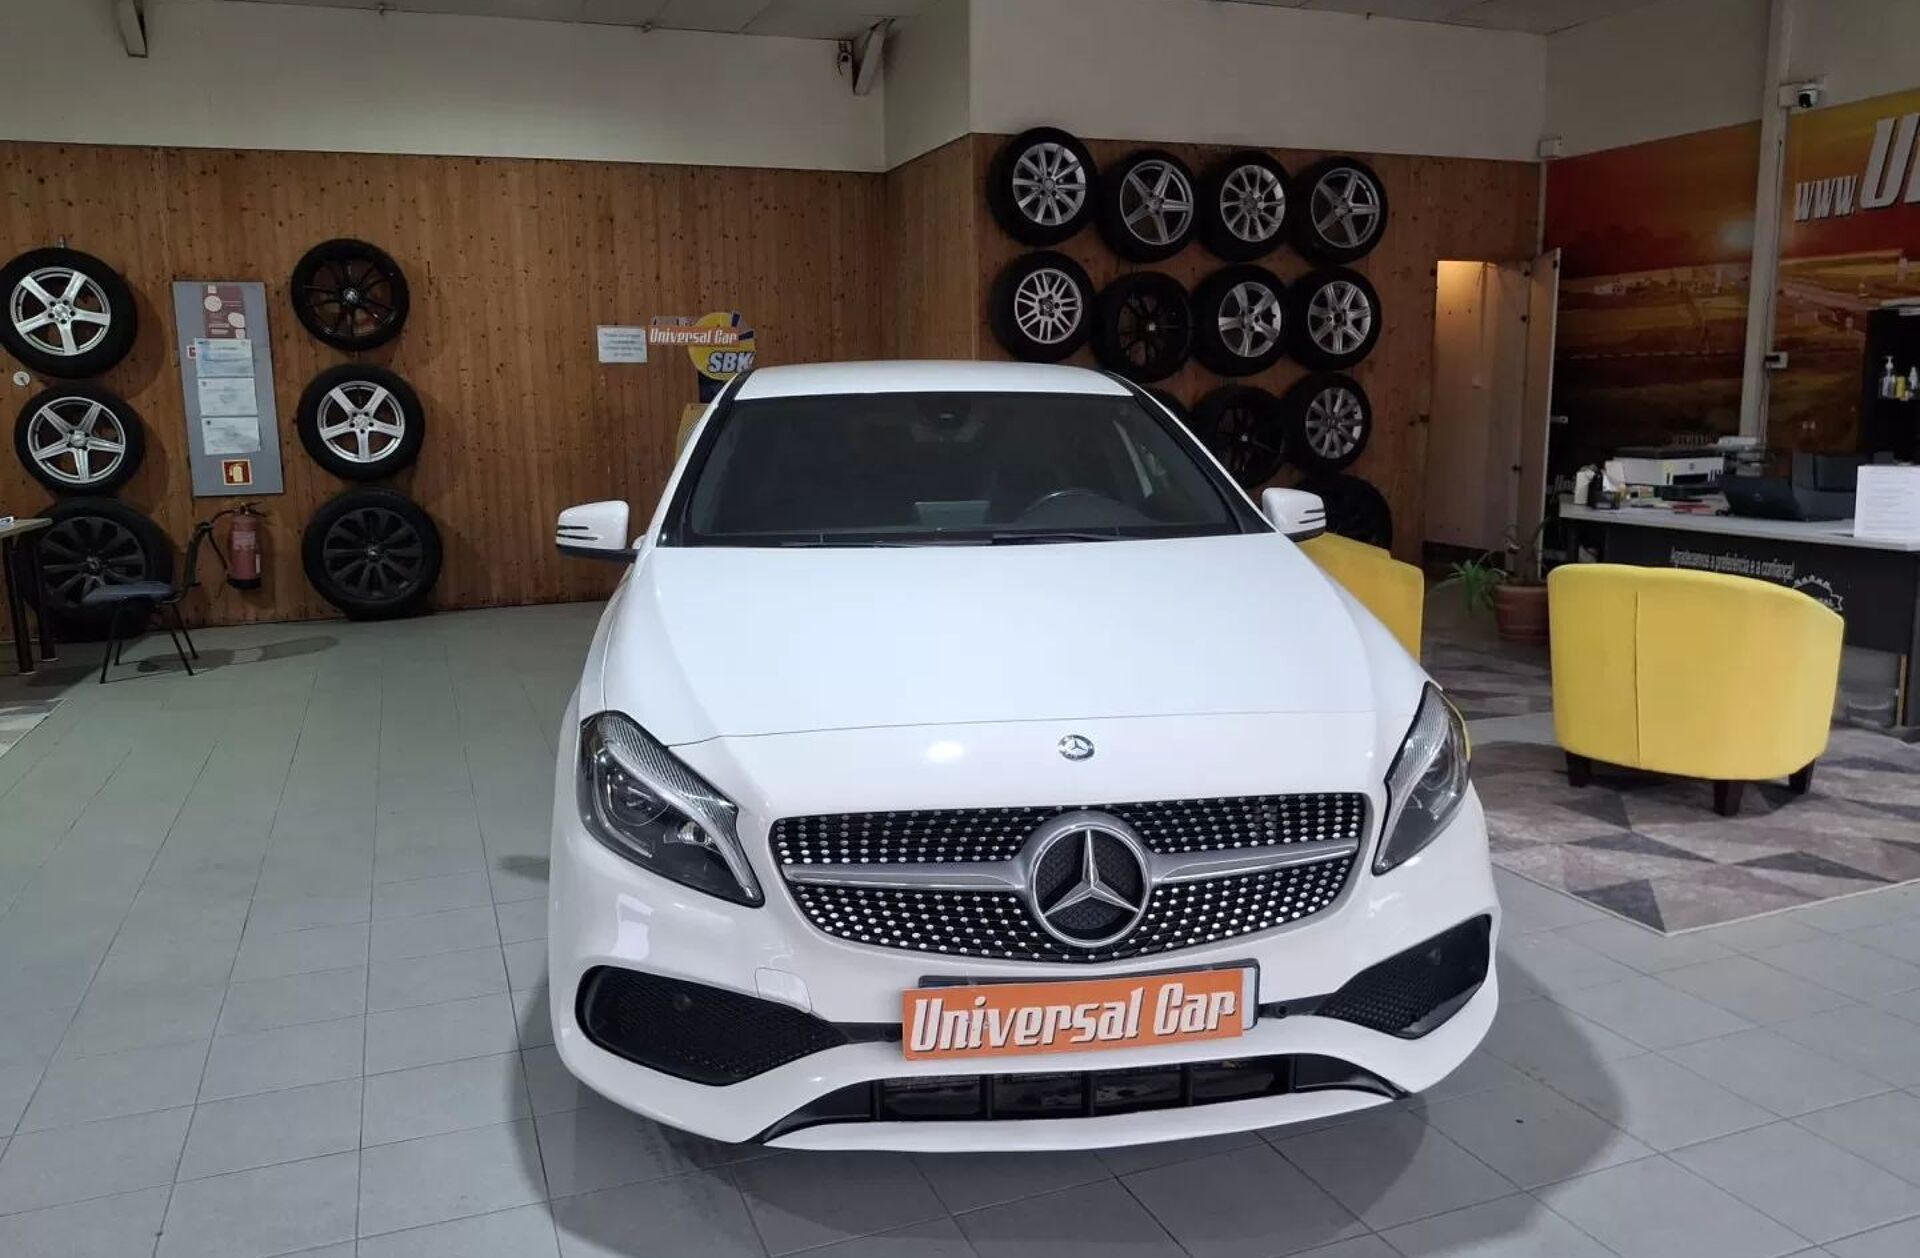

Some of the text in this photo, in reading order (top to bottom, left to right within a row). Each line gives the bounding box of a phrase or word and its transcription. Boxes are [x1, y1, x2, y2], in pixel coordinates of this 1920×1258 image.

[650, 327, 738, 345] Universal Car
[910, 982, 1237, 1052] Universal Car
